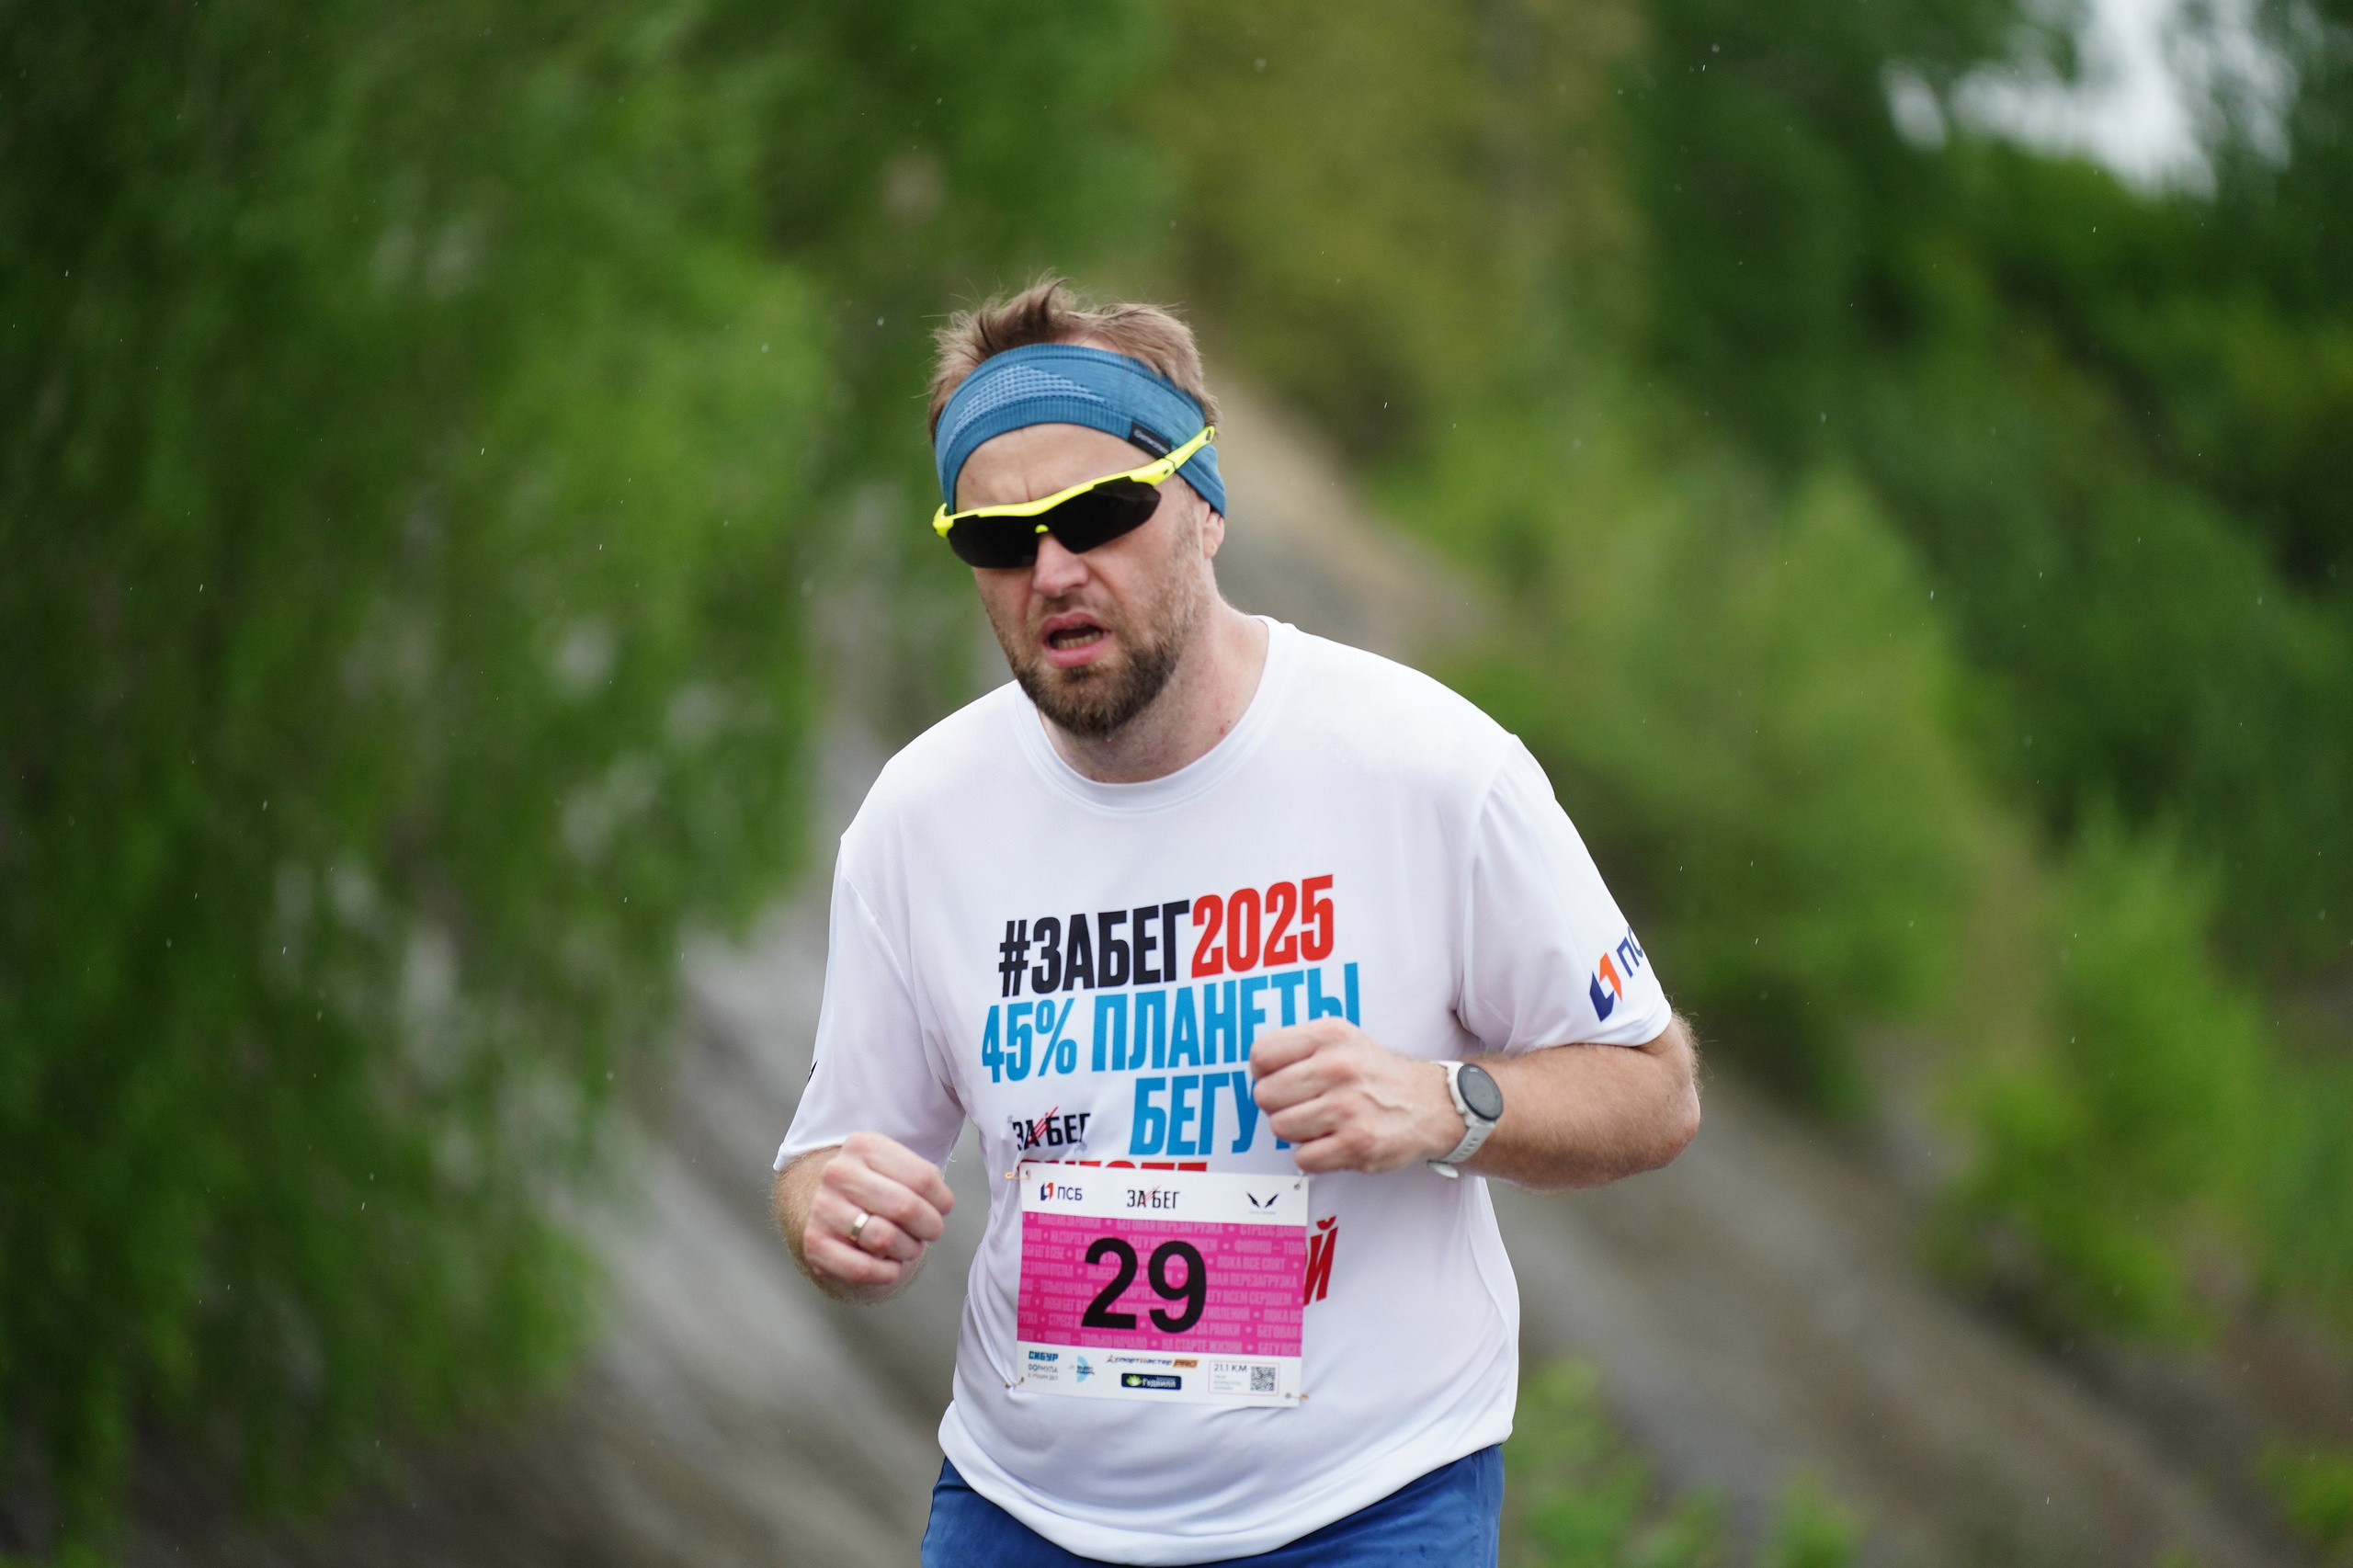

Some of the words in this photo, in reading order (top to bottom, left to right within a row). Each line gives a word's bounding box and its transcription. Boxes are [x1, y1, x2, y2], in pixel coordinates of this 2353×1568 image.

[997, 873, 1335, 998] #ЗАБЕГ2025
[982, 996, 1078, 1084] 45%
[1091, 962, 1360, 1073] ПЛАНЕТЫ
[1128, 1071, 1291, 1156] БЕГУ
[1057, 1186, 1083, 1201] ПСБ
[1081, 1237, 1207, 1333] 29
[1029, 1350, 1059, 1362] СИБУР
